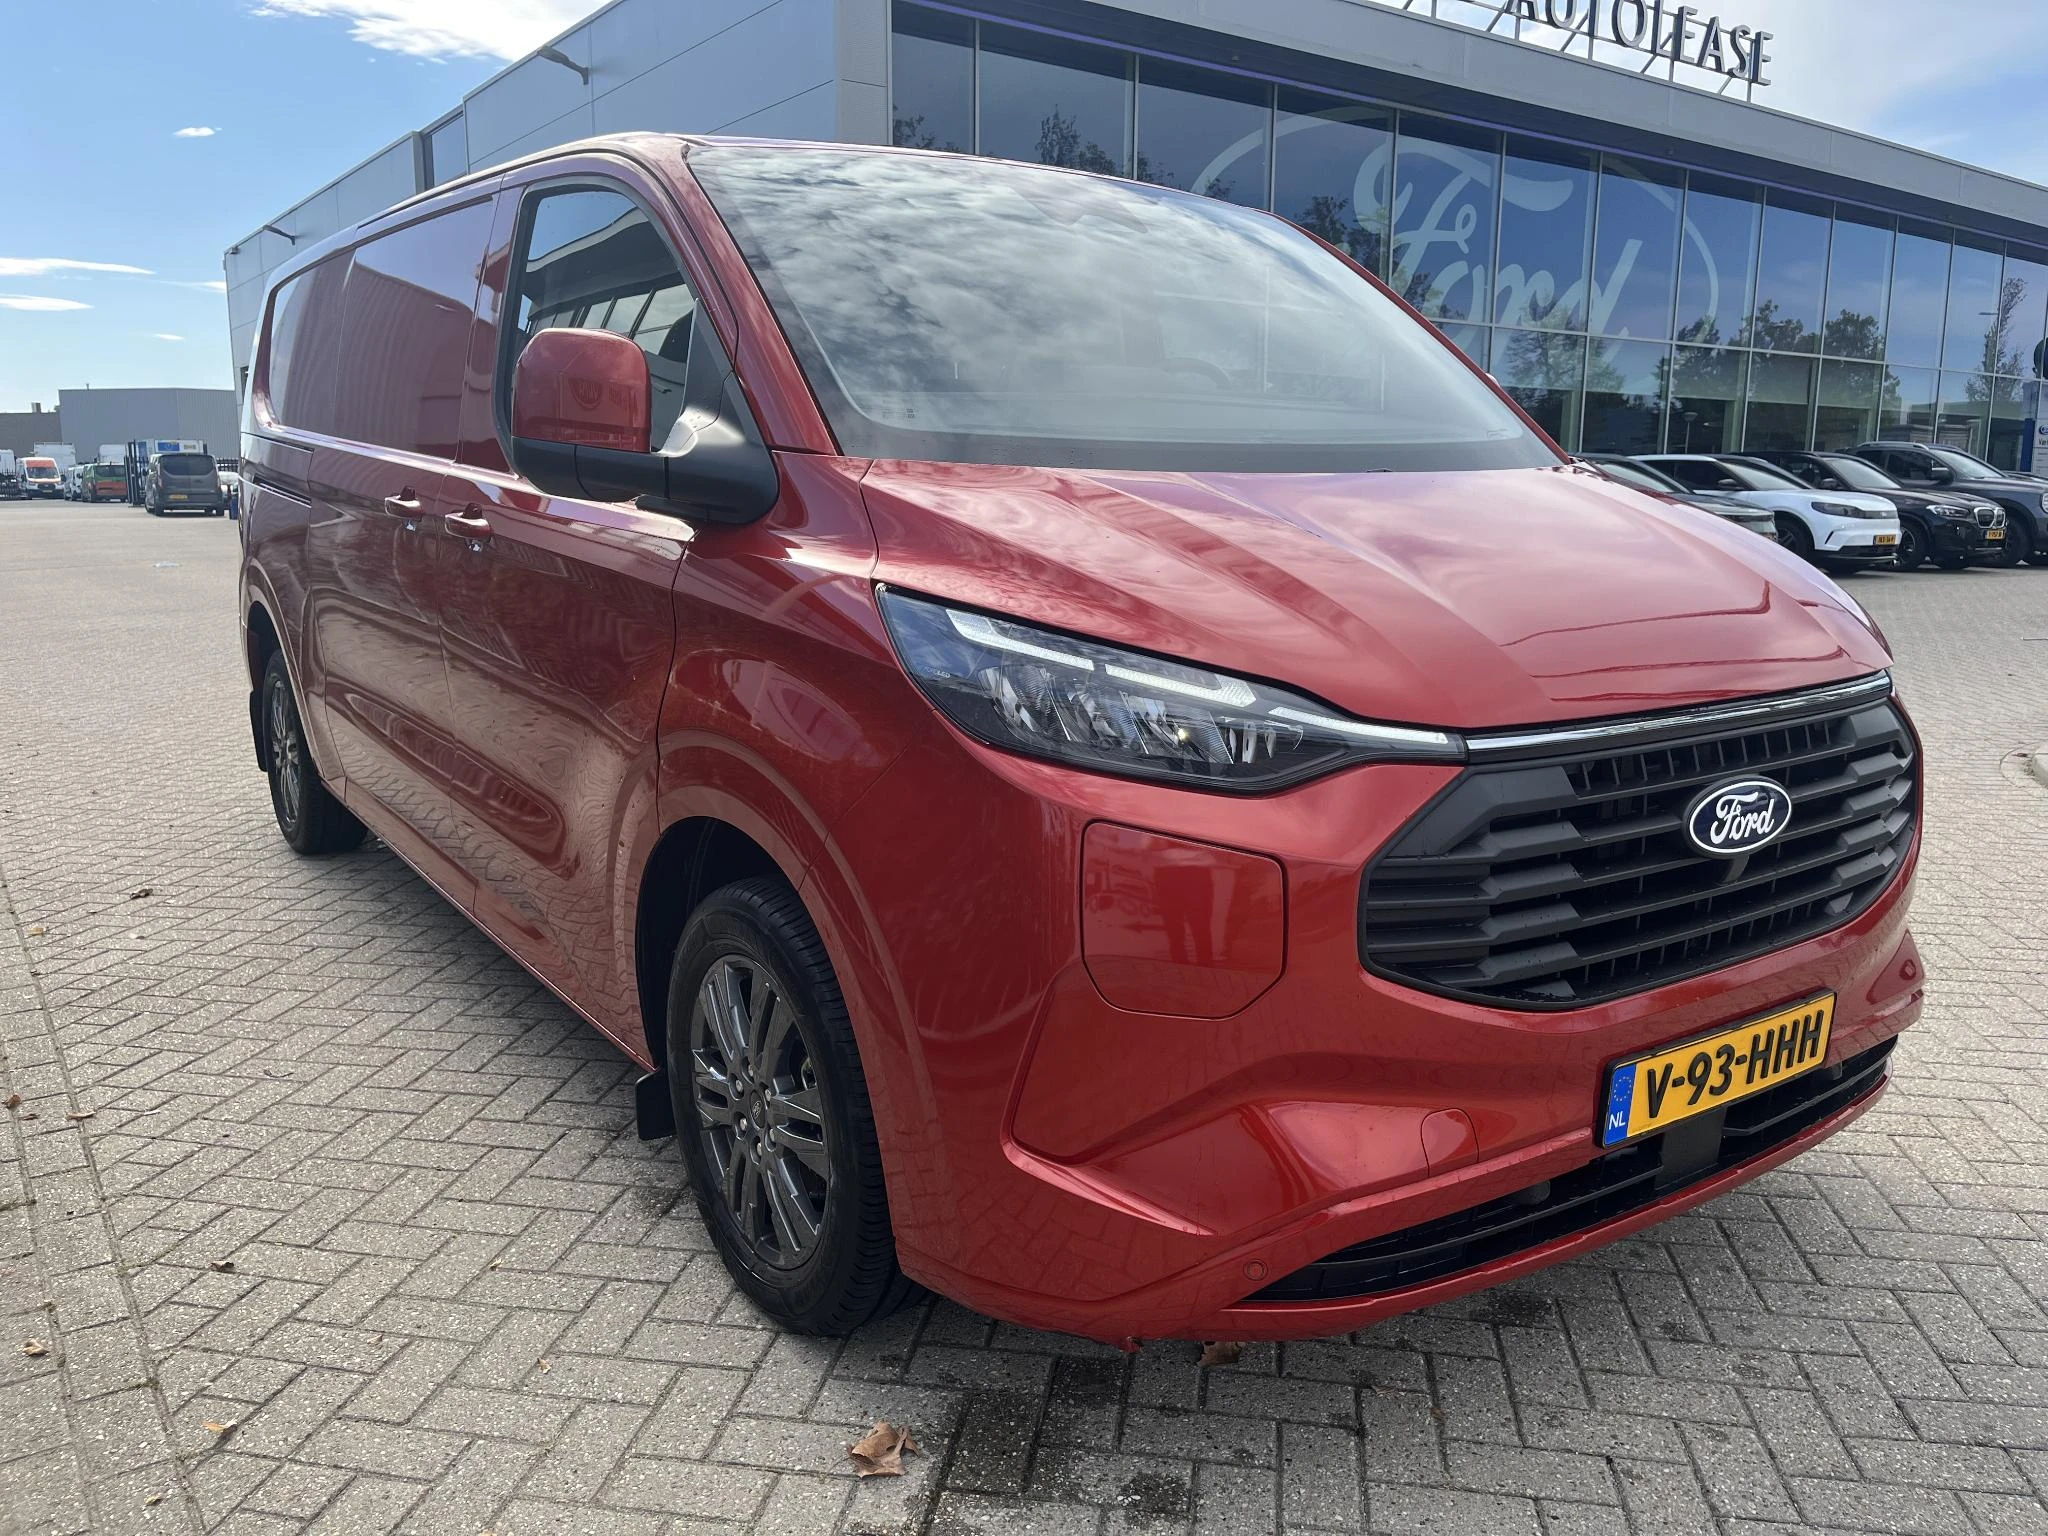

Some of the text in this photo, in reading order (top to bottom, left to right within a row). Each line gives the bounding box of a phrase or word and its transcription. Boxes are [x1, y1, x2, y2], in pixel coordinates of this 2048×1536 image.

[1337, 136, 1644, 366] Ford
[1710, 791, 1775, 844] Ford
[1647, 1009, 1825, 1119] V-93-HHH
[1608, 1110, 1626, 1130] NL
